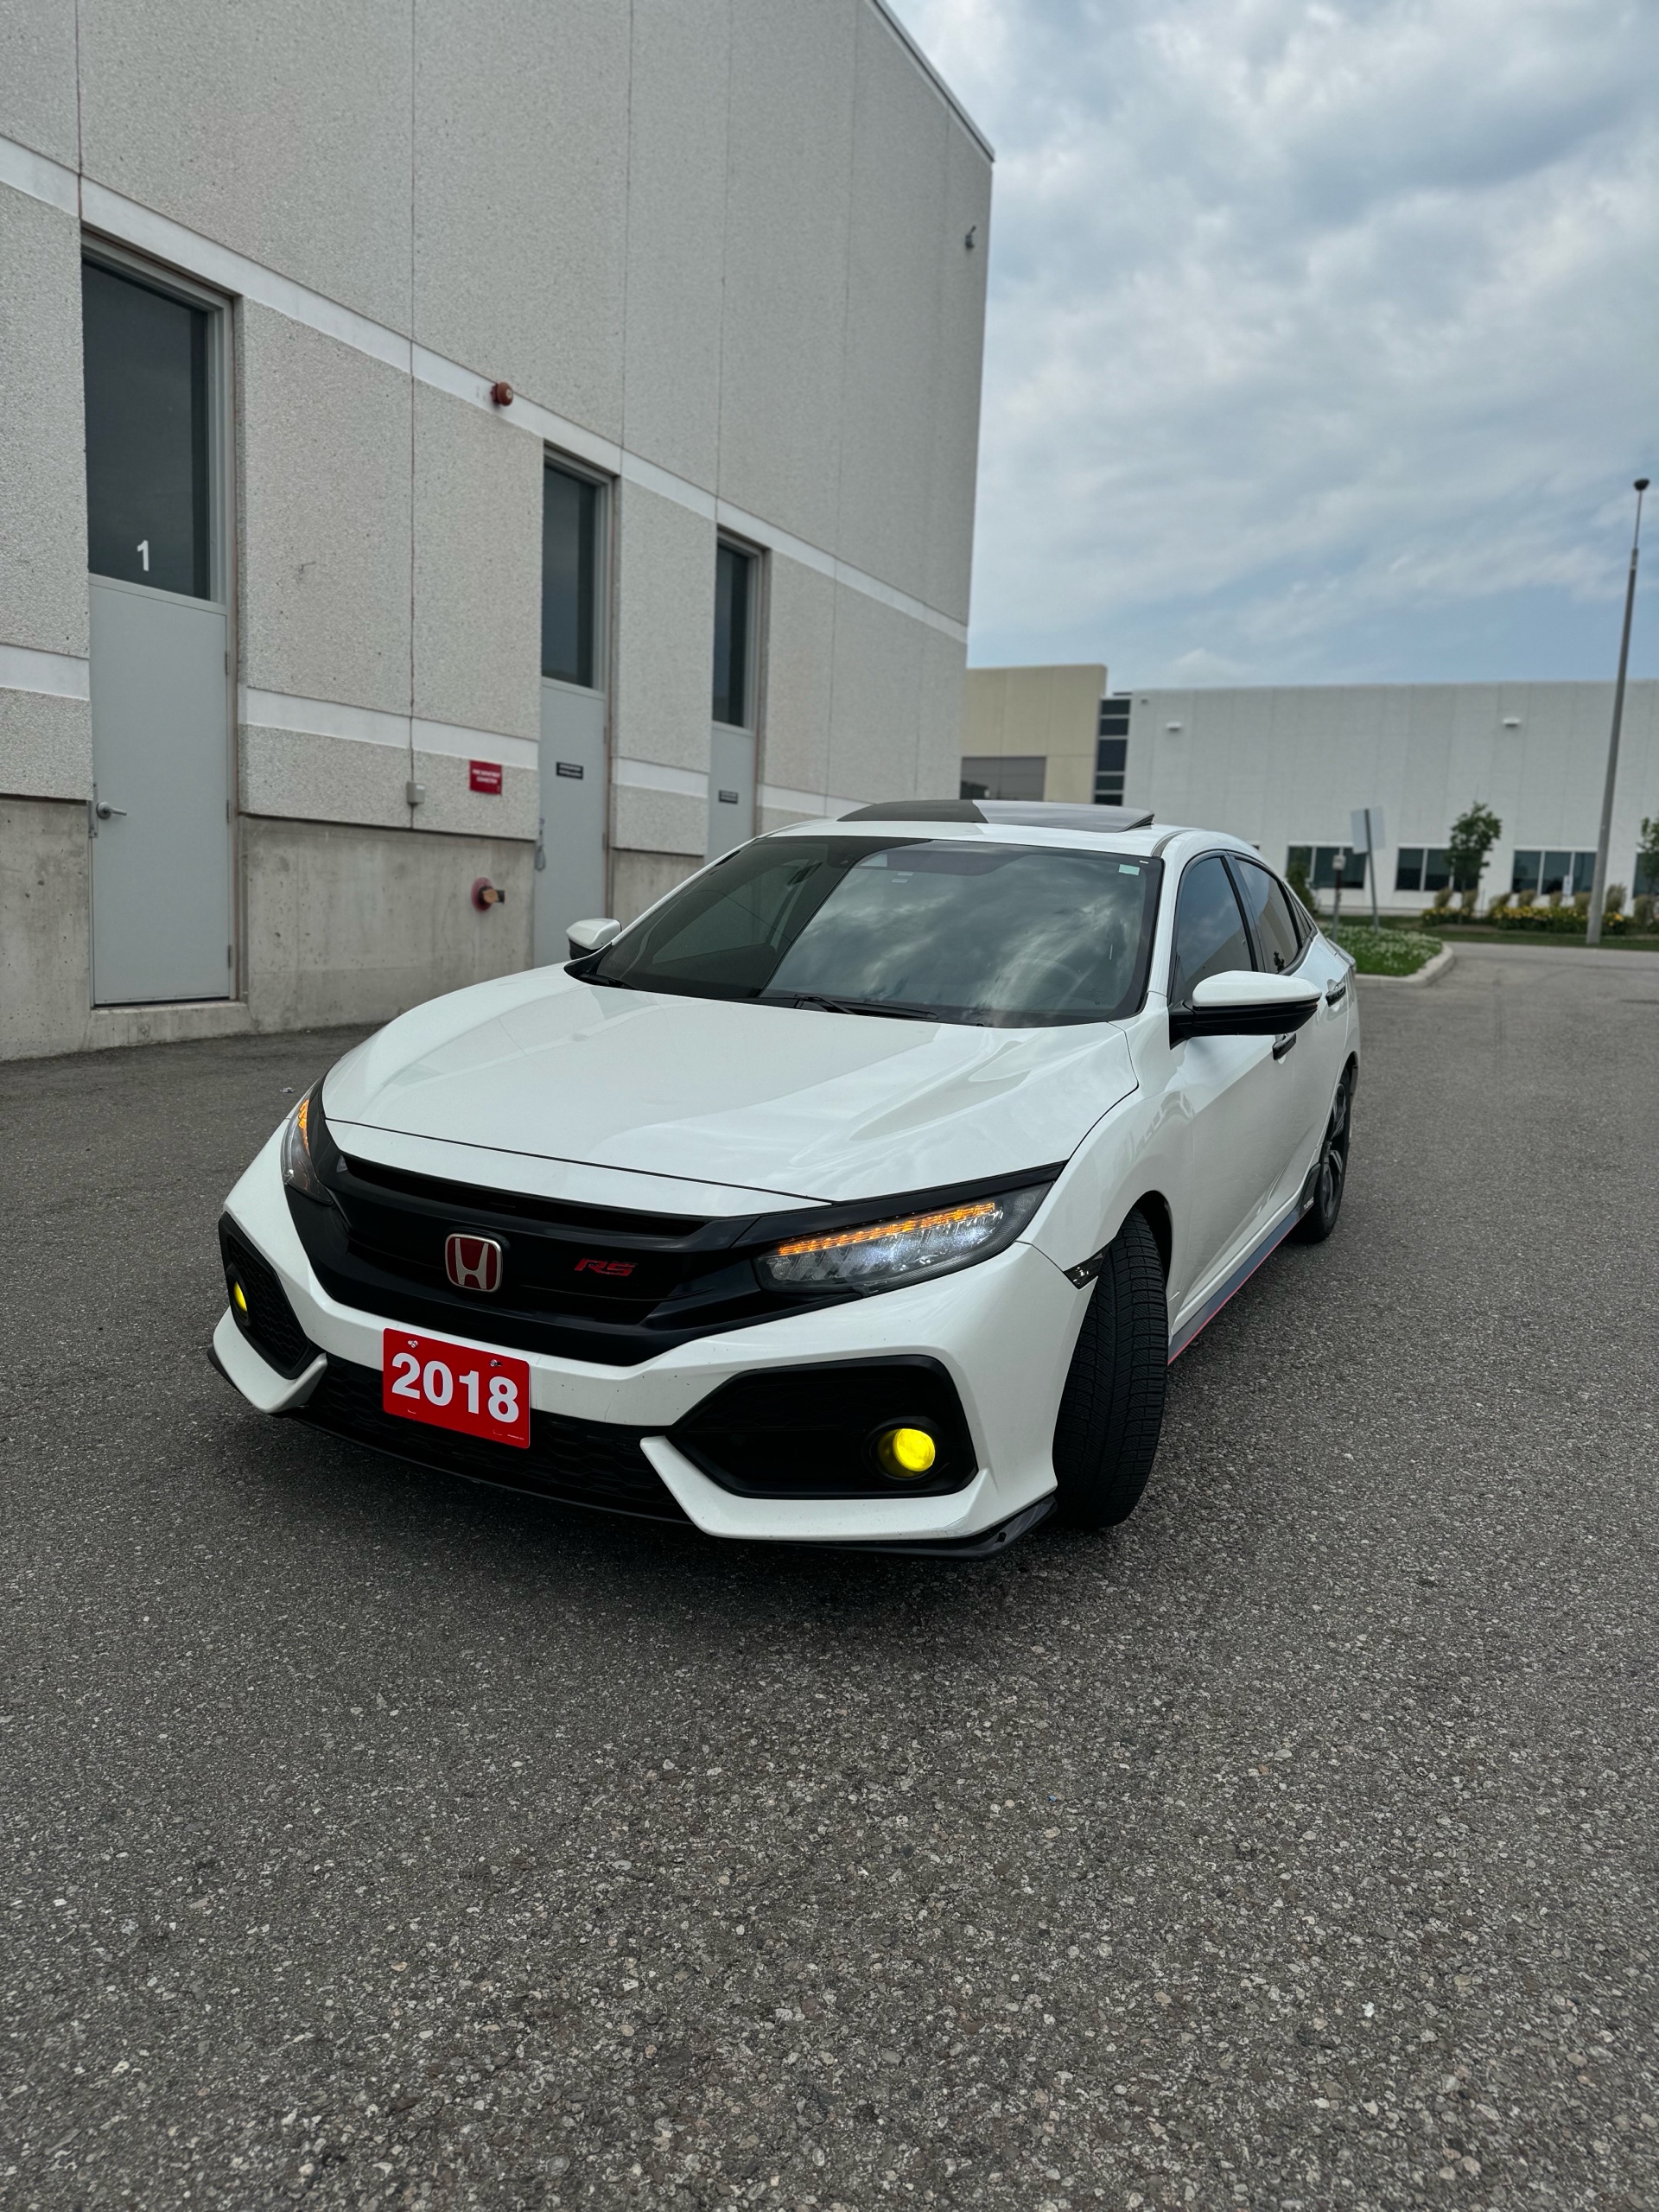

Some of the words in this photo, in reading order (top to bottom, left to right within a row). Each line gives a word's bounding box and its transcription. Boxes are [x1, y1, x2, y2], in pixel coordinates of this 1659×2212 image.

[137, 539, 149, 572] 1
[454, 1237, 489, 1290] H
[574, 1258, 638, 1276] RS
[391, 1352, 519, 1423] 2018
